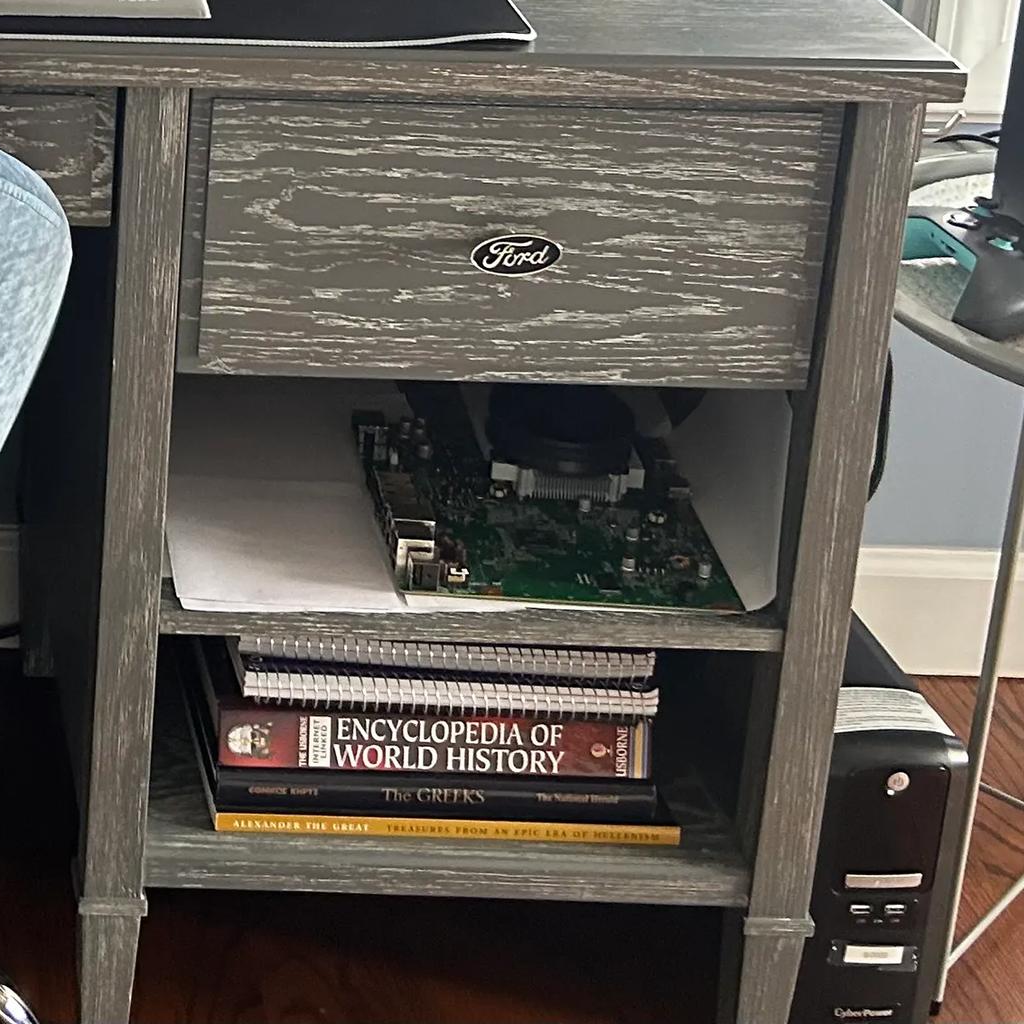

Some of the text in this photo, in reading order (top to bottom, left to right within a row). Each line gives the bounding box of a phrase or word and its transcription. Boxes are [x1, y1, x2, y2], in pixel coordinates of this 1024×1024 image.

[482, 240, 550, 269] Ford
[312, 719, 320, 764] INTERNET
[320, 725, 328, 759] LINKED
[337, 717, 564, 747] ENCYCLOPEDIA OF
[298, 751, 308, 767] THE
[333, 743, 565, 774] WORLD HISTORY
[615, 726, 628, 777] USBORNE
[381, 787, 486, 804] The GREEKS
[232, 819, 301, 830] ALEXANDER
[305, 821, 327, 831] THE
[332, 823, 369, 832] GREAT
[455, 826, 488, 835] FROM
[494, 827, 508, 836] AN
